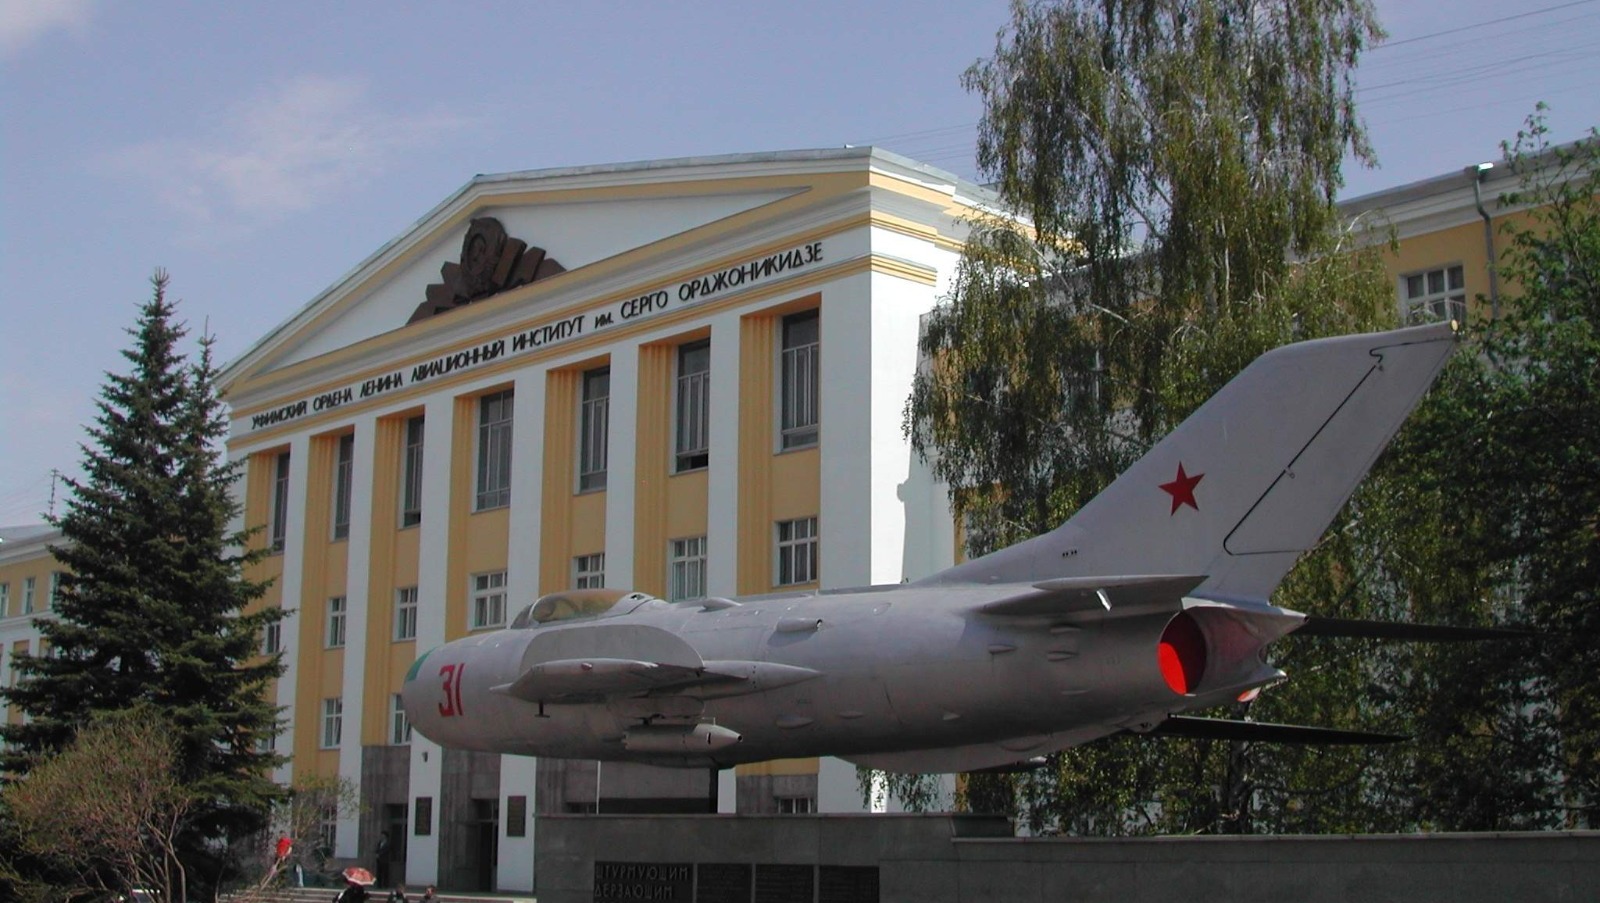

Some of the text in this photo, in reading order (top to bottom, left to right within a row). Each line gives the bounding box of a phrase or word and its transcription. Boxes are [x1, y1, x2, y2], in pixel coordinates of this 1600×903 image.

[252, 400, 306, 430] УФИМСКИЙ
[313, 388, 352, 412] ОРДЕНА
[360, 372, 402, 399] ЛЕНИНА
[411, 340, 504, 383] АВИАЦИОННЫЙ
[513, 315, 585, 351] ИНСТИТУТ
[621, 291, 668, 319] СЕРГО
[679, 242, 823, 301] ОРДЖОНИКИДЗЕ
[438, 663, 464, 717] 31
[595, 865, 688, 881] ШТУРМУЮЩИМ
[594, 883, 673, 900] ДЕРЗАЮЩИМ
